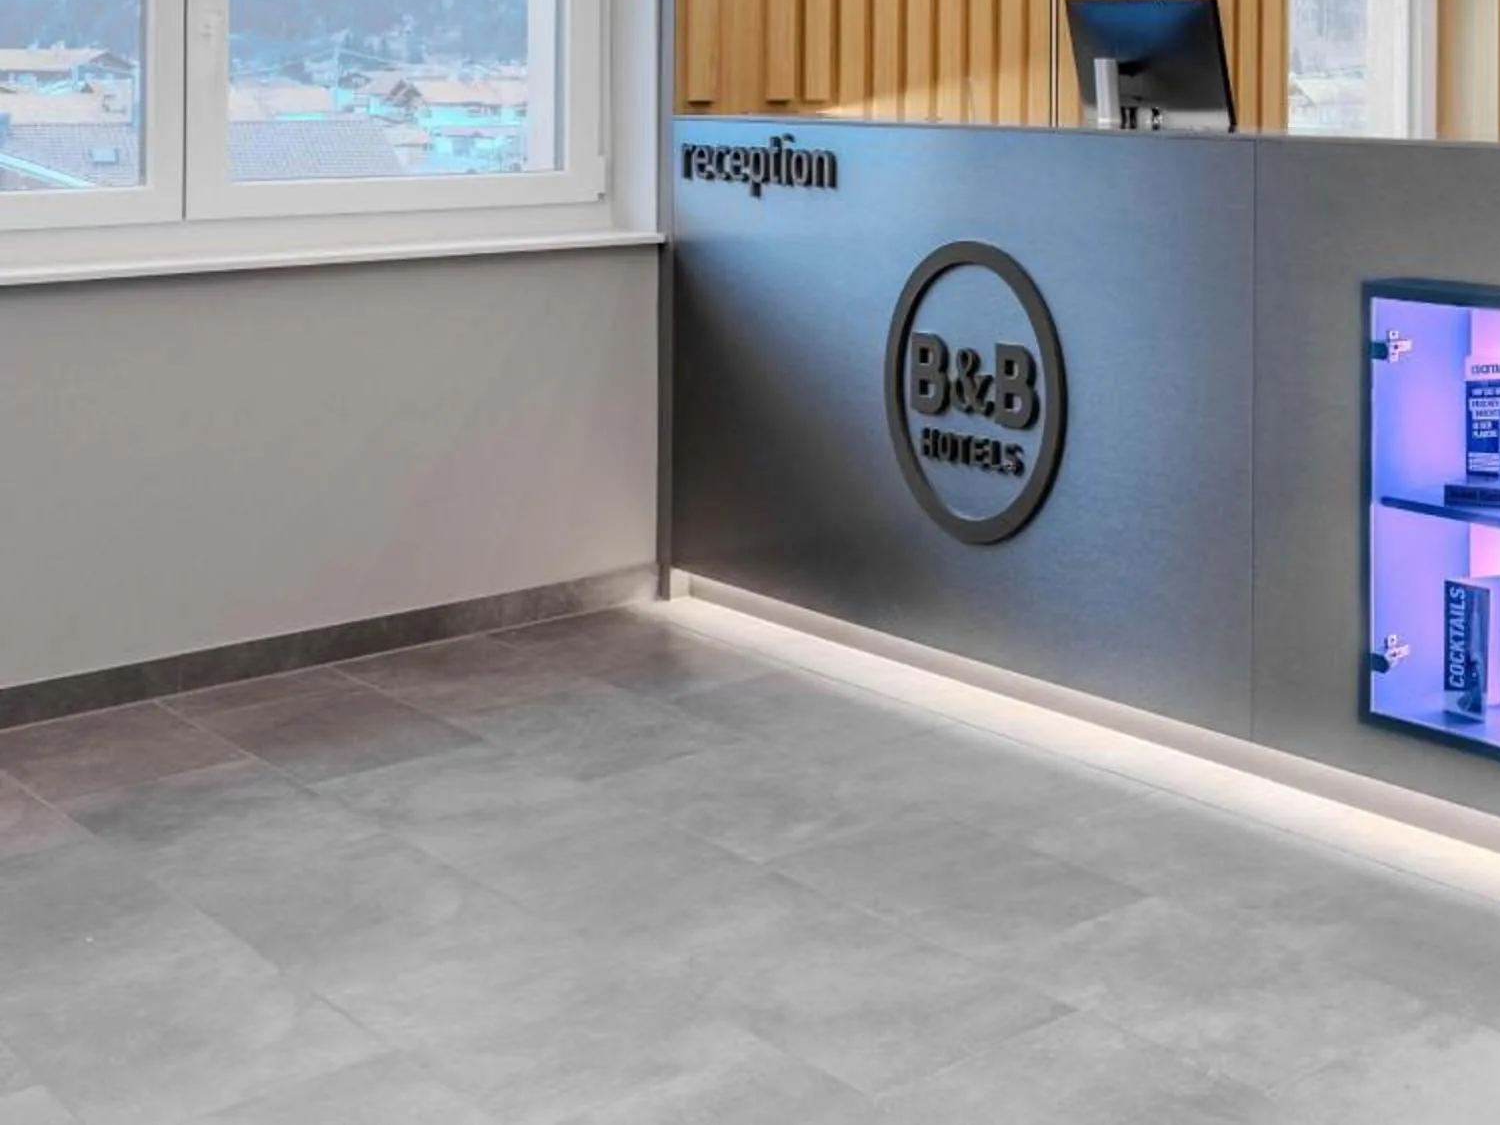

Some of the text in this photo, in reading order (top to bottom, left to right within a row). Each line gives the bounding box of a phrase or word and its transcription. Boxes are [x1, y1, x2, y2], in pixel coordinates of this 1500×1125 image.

[680, 134, 838, 198] reception
[910, 331, 1041, 431] B&B
[921, 426, 1026, 476] HOTELS
[1449, 586, 1467, 689] COCKTAILS
